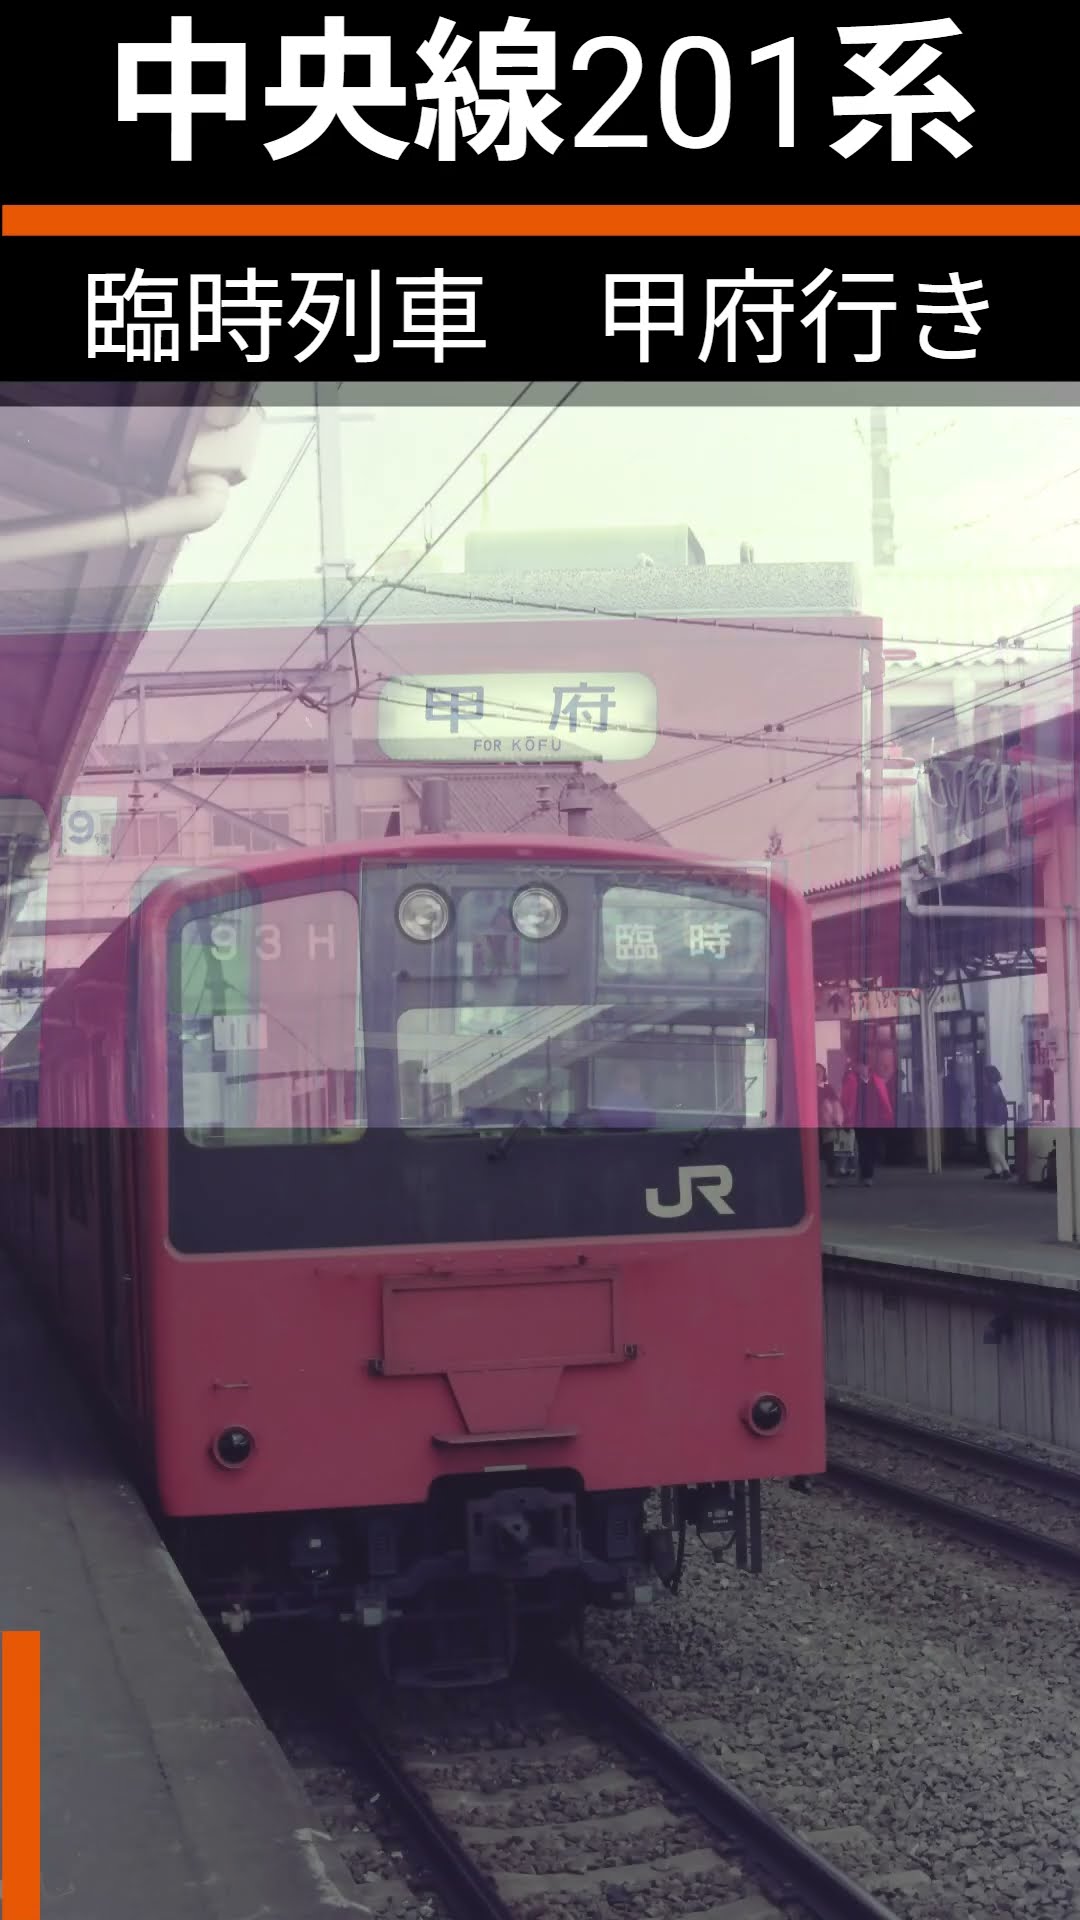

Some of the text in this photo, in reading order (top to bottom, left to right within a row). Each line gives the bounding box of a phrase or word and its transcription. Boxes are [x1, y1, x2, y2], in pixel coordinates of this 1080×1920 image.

[474, 739, 501, 751] FOR
[68, 810, 94, 845] 9
[645, 1164, 736, 1218] JR
